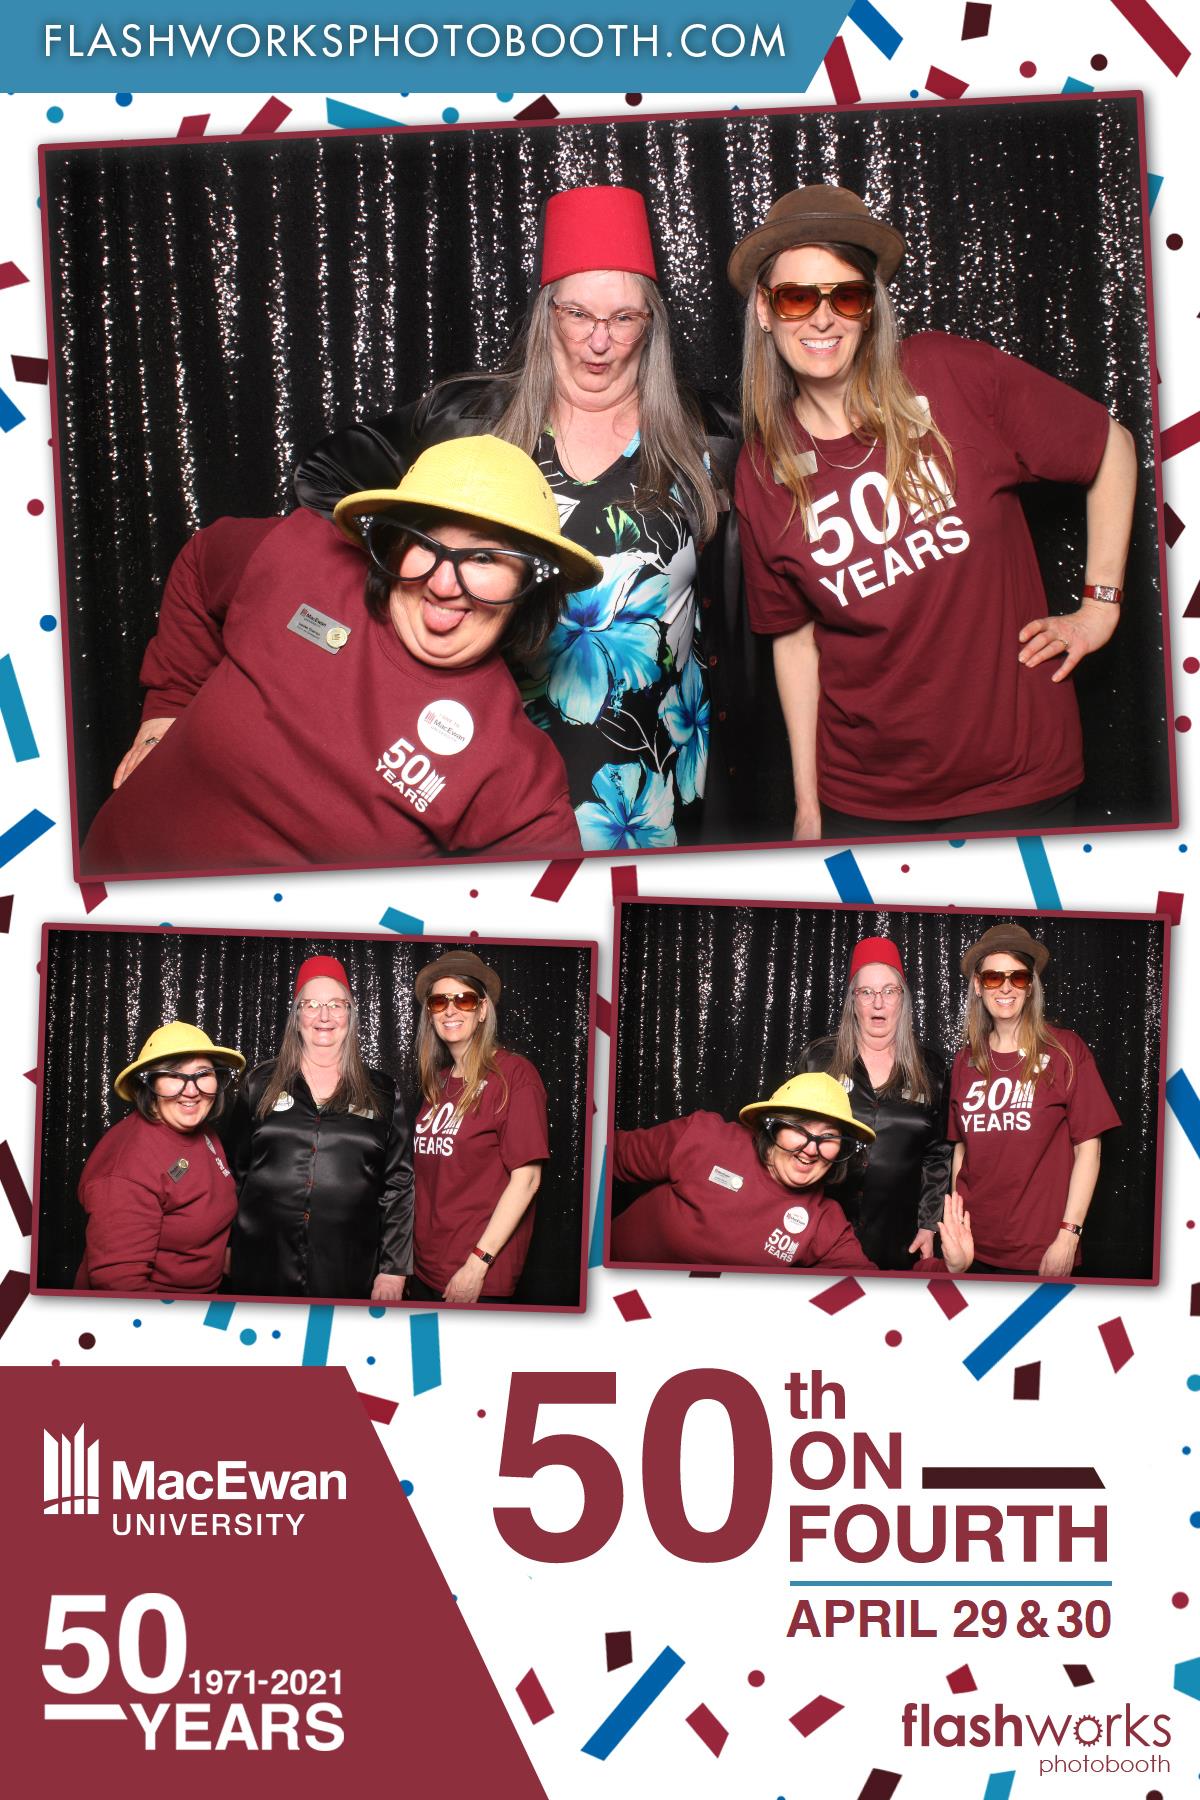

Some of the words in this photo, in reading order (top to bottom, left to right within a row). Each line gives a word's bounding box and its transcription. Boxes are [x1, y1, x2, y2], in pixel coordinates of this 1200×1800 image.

[807, 471, 900, 566] 50
[818, 516, 970, 607] YEARS
[433, 719, 465, 742] MacEwan
[383, 738, 430, 785] 50
[375, 758, 428, 813] YEARS
[962, 1077, 1012, 1111] 50
[961, 1111, 1031, 1132] YEARS
[413, 1136, 453, 1156] YEARS
[764, 1241, 793, 1263] YEARS
